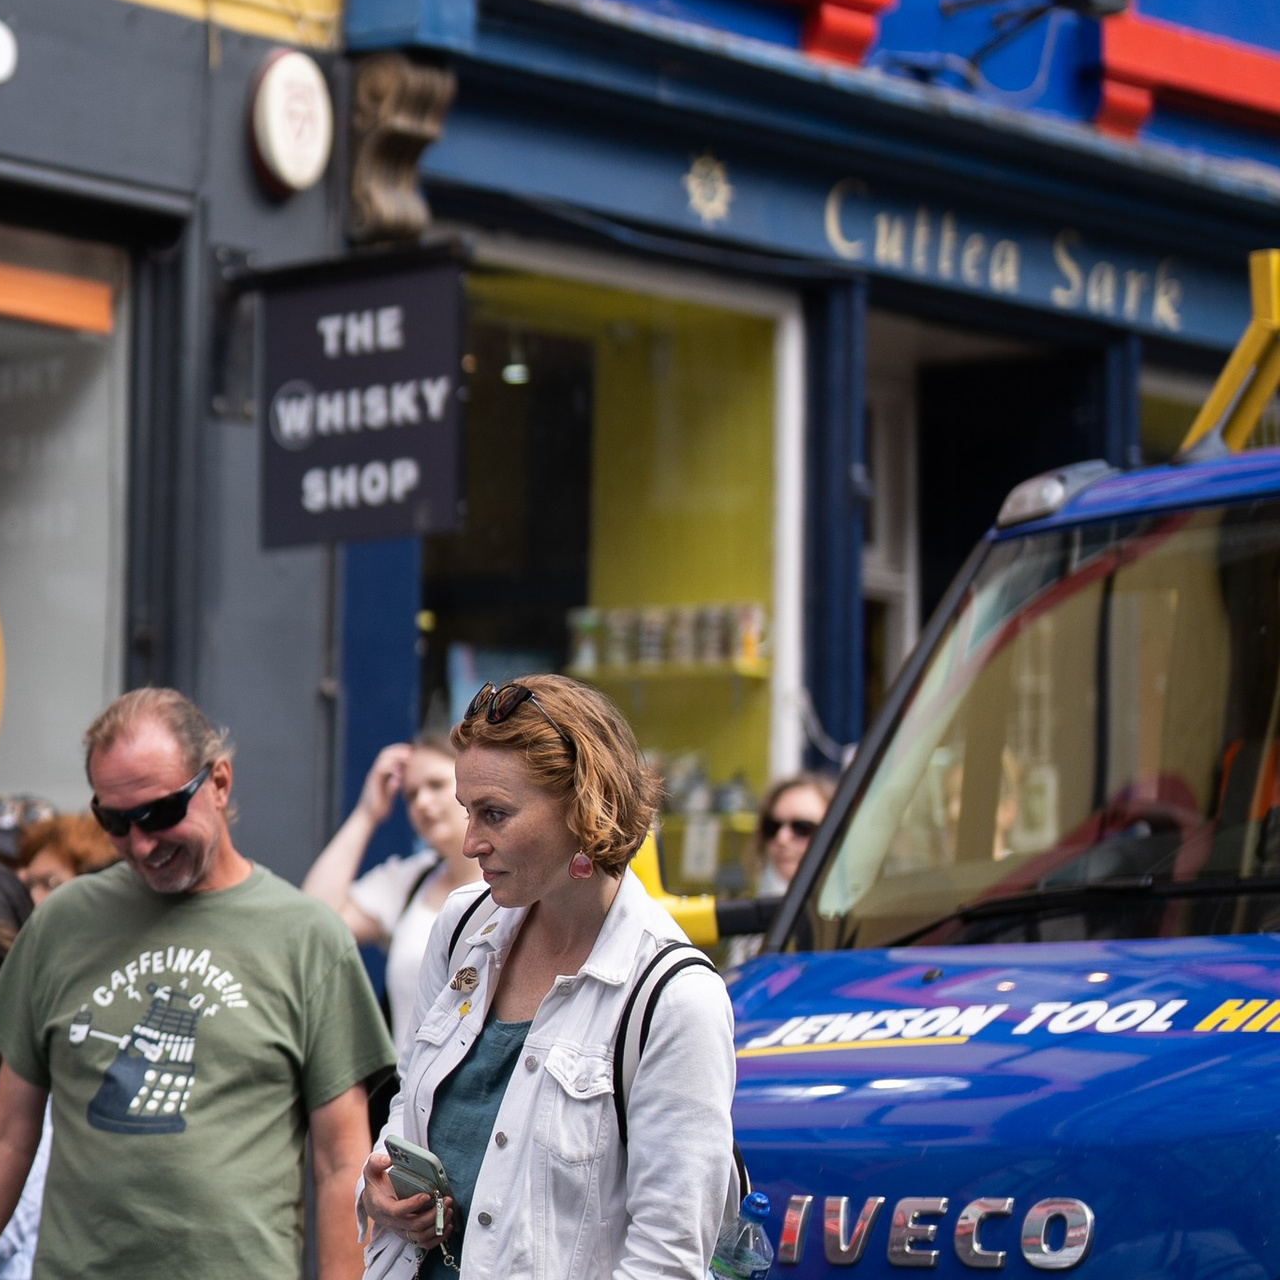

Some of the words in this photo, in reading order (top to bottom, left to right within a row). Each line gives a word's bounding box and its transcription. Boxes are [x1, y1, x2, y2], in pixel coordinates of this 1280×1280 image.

[1051, 227, 1186, 333] Sark
[317, 305, 404, 359] THE
[273, 375, 451, 441] WHISKY
[301, 457, 419, 514] SHOP
[745, 1003, 1010, 1050] JEWSON
[1012, 999, 1189, 1036] TOOL
[1193, 999, 1280, 1033] HI
[777, 1194, 1096, 1272] IVECO
